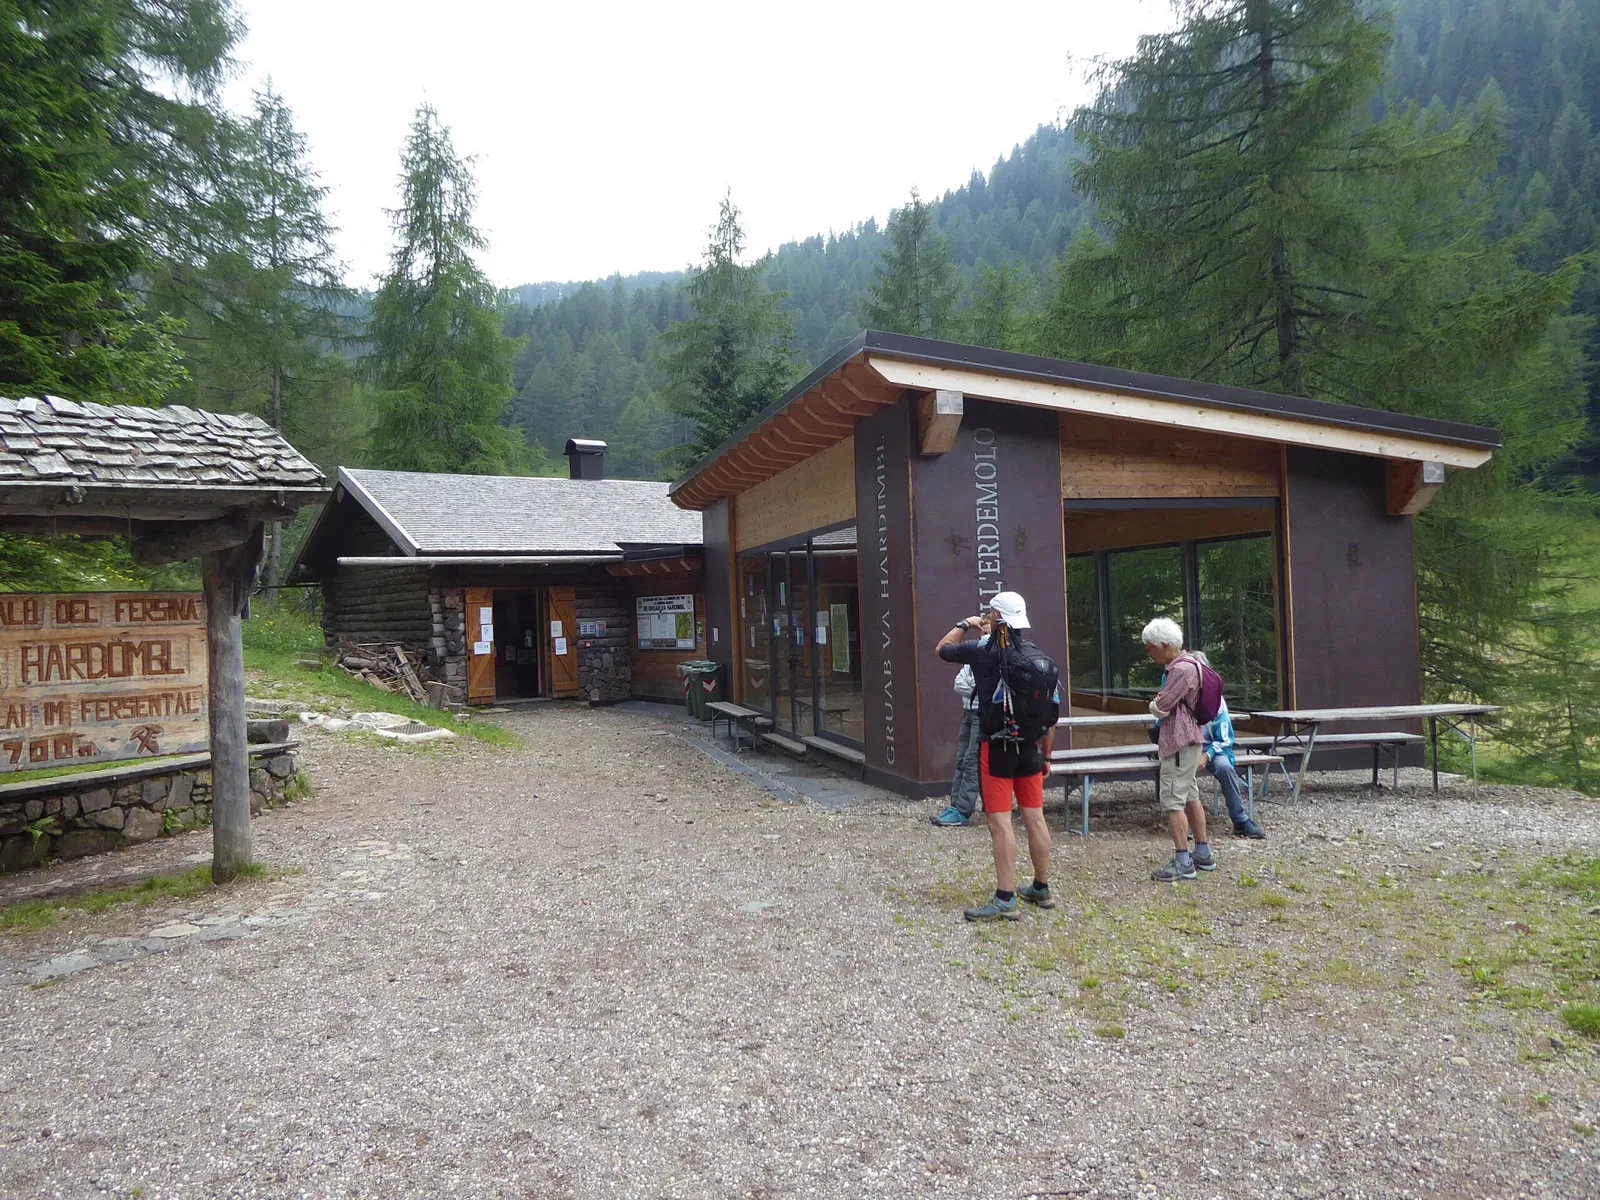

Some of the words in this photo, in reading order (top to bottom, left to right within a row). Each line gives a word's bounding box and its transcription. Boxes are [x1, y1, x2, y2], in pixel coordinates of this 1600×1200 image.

[974, 427, 1003, 618] L'ERDEMOLO
[56, 599, 98, 624] DEL
[115, 598, 199, 623] FERSINA
[881, 608, 892, 650] VA
[0, 703, 26, 729] AI
[44, 700, 65, 726] IM
[81, 691, 200, 723] FERSENTAL
[883, 659, 896, 765] GRUAB
[3, 738, 74, 764] 700
